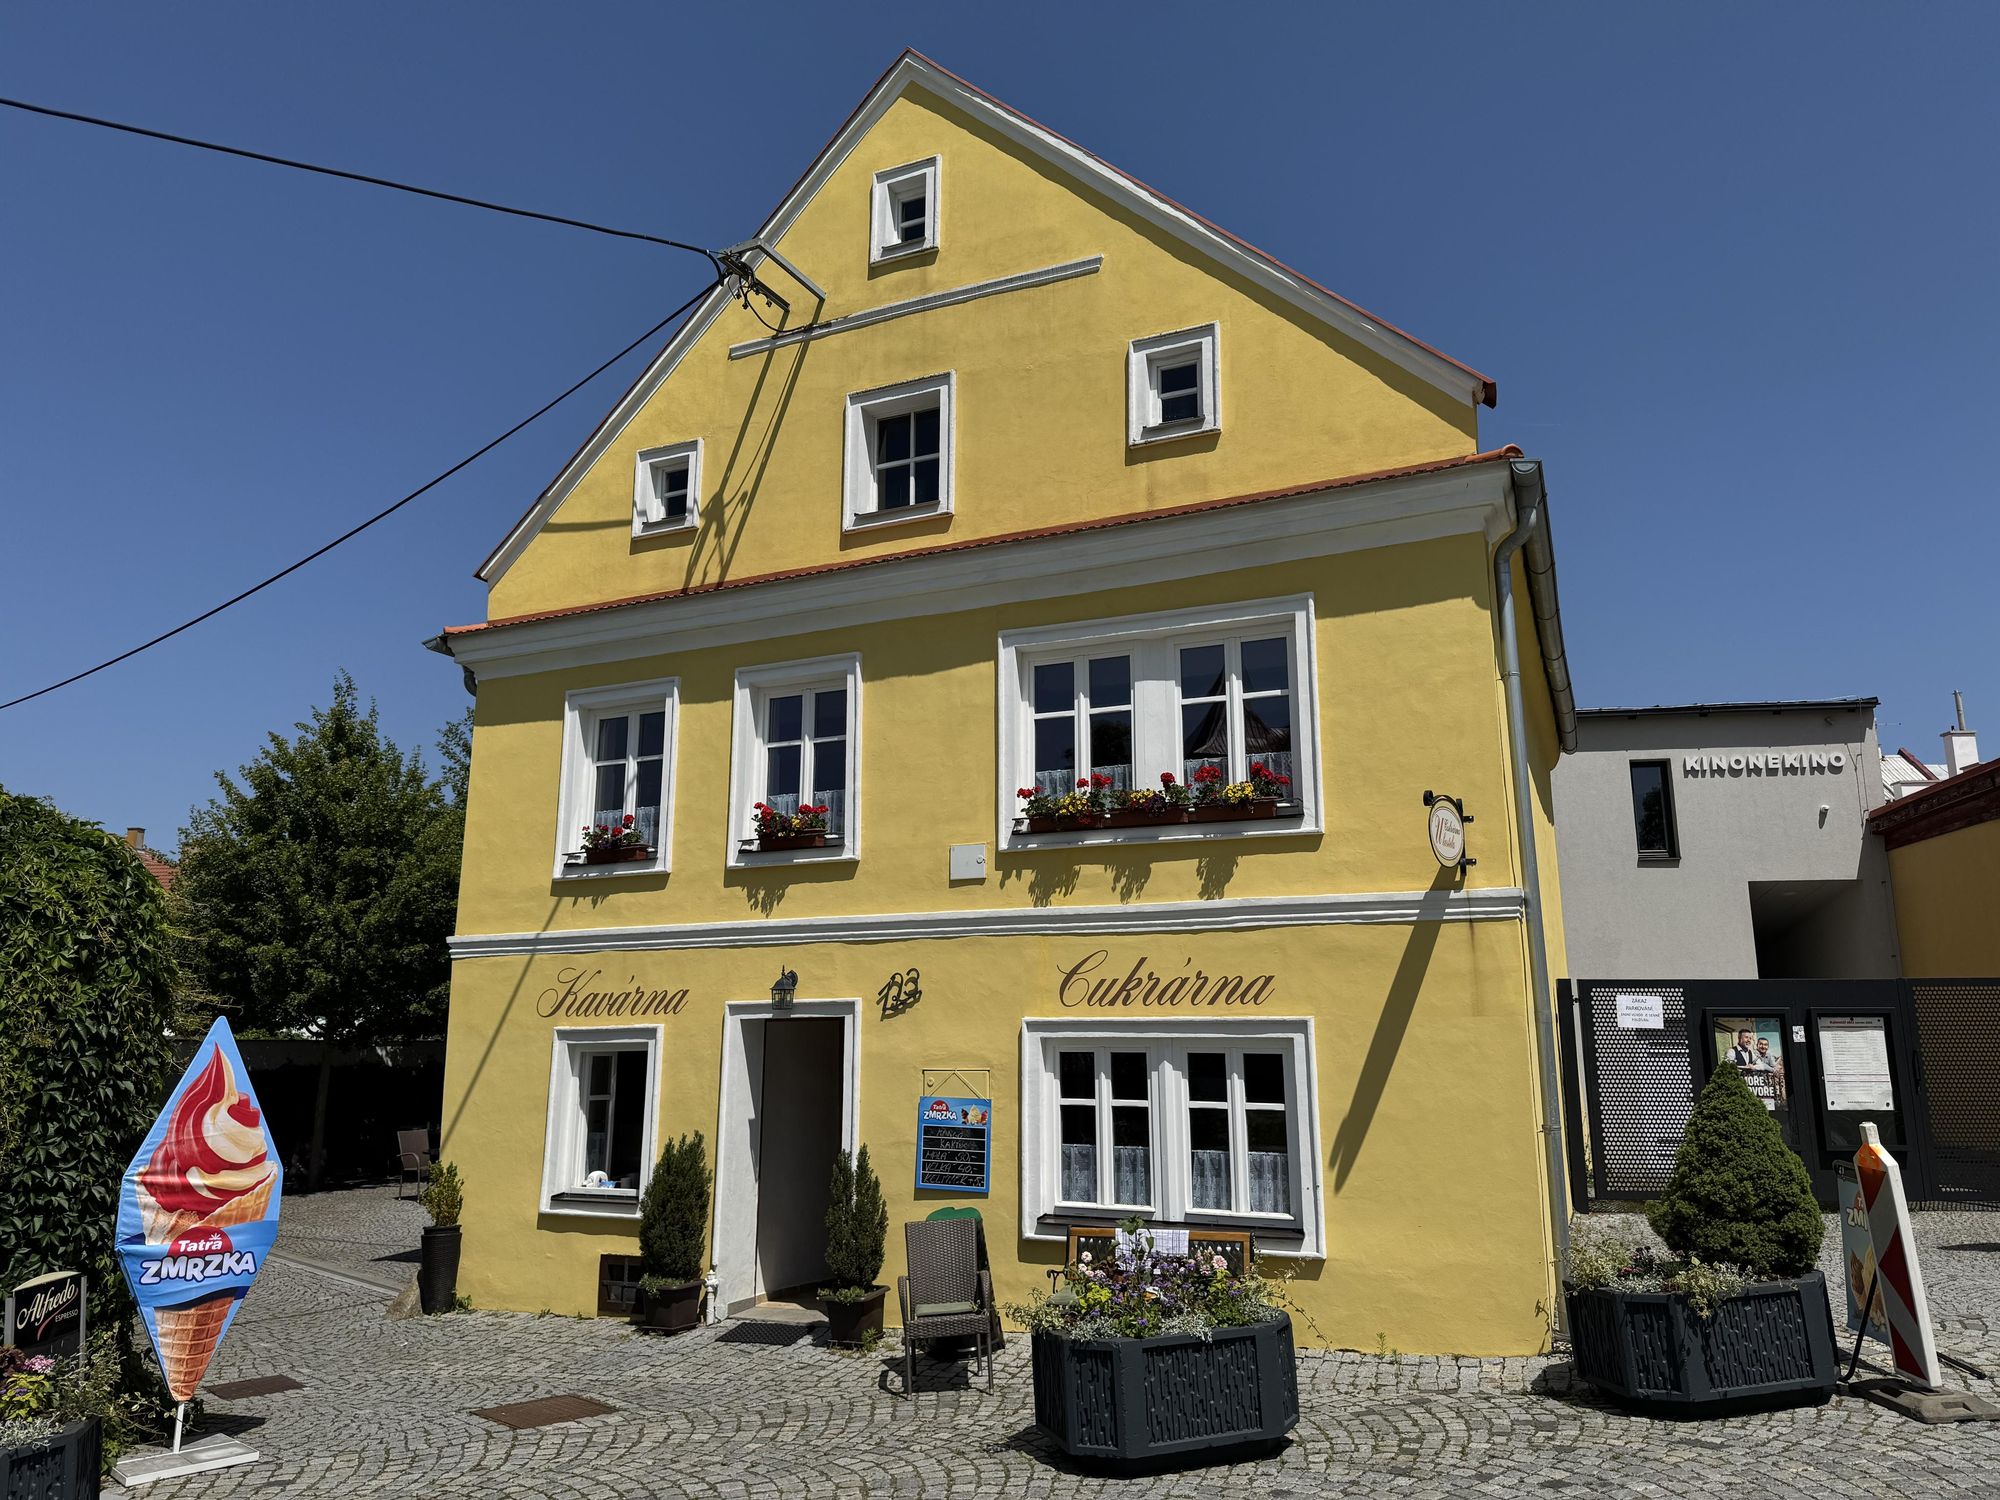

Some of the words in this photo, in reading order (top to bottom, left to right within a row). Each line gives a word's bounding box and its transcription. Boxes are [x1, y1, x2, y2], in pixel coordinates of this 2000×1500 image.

[1685, 751, 1847, 772] KINONEKINO
[1056, 949, 1276, 1008] Cukrárna
[536, 967, 690, 1018] Kavárna
[923, 1110, 957, 1120] ZMRZKA
[178, 1239, 223, 1252] Tatra
[140, 1251, 257, 1284] ZMRZKA
[16, 1278, 76, 1330] Alfredo
[55, 1308, 79, 1322] ESPRESSO
